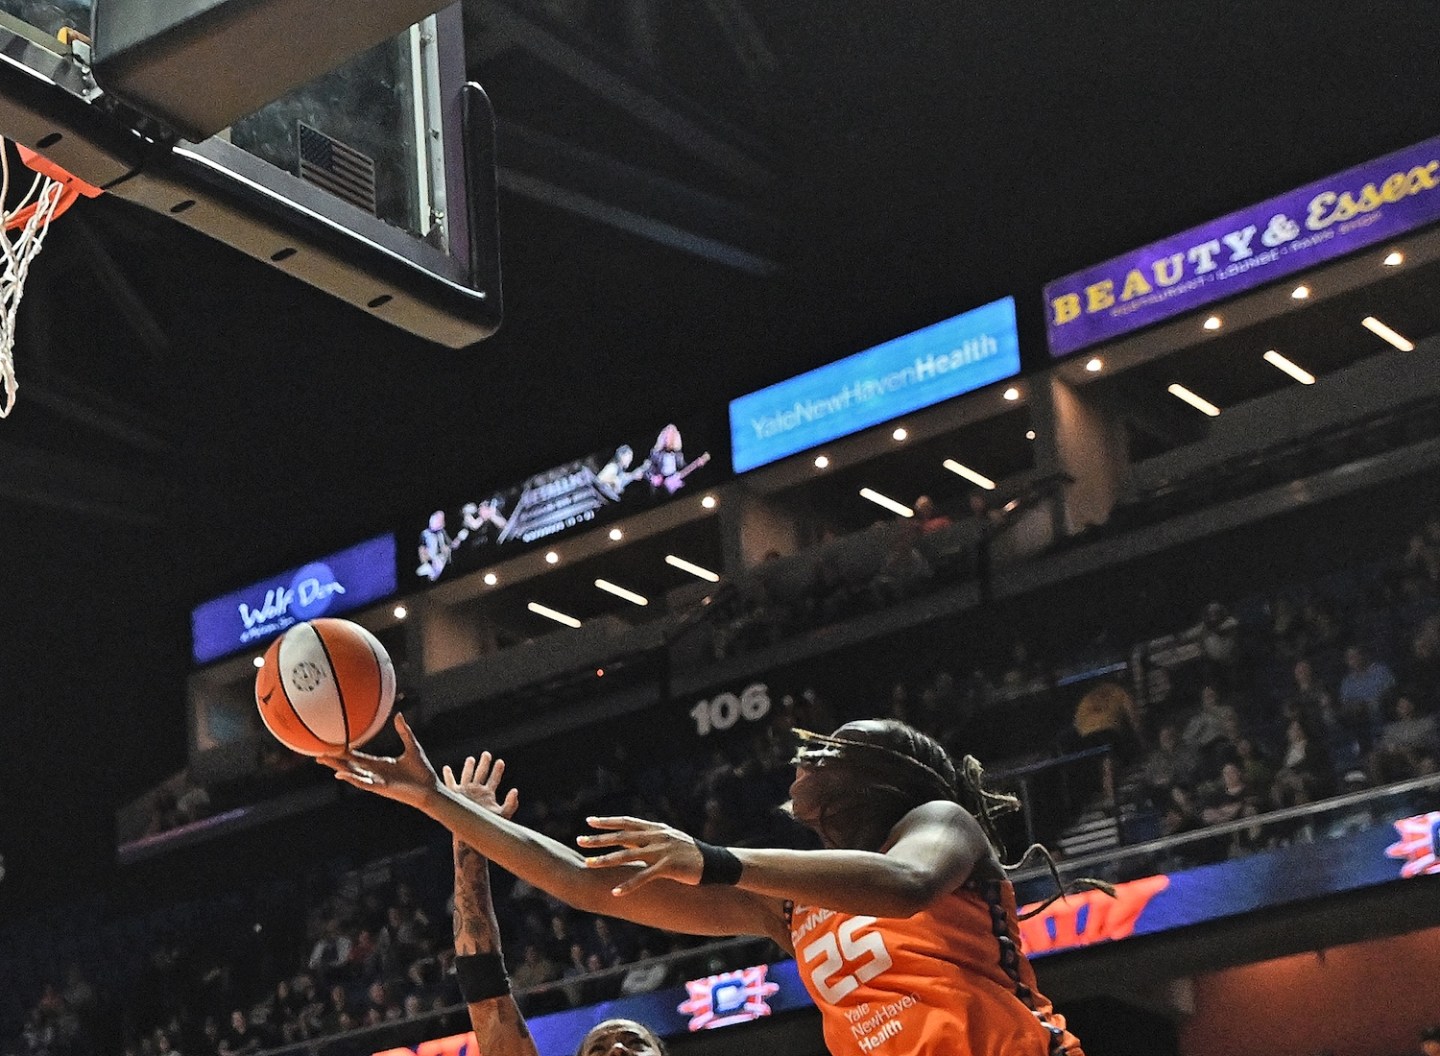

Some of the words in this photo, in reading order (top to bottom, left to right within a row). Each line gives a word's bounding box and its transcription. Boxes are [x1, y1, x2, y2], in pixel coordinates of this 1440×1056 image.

[1051, 224, 1257, 326] BEAUTY
[1261, 212, 1300, 248] &
[1305, 159, 1440, 231] Essex
[690, 683, 771, 736] 106
[803, 915, 893, 1006] 25
[844, 1002, 871, 1024] Yale
[850, 991, 922, 1039] NewHaven
[858, 1018, 904, 1054] Health
